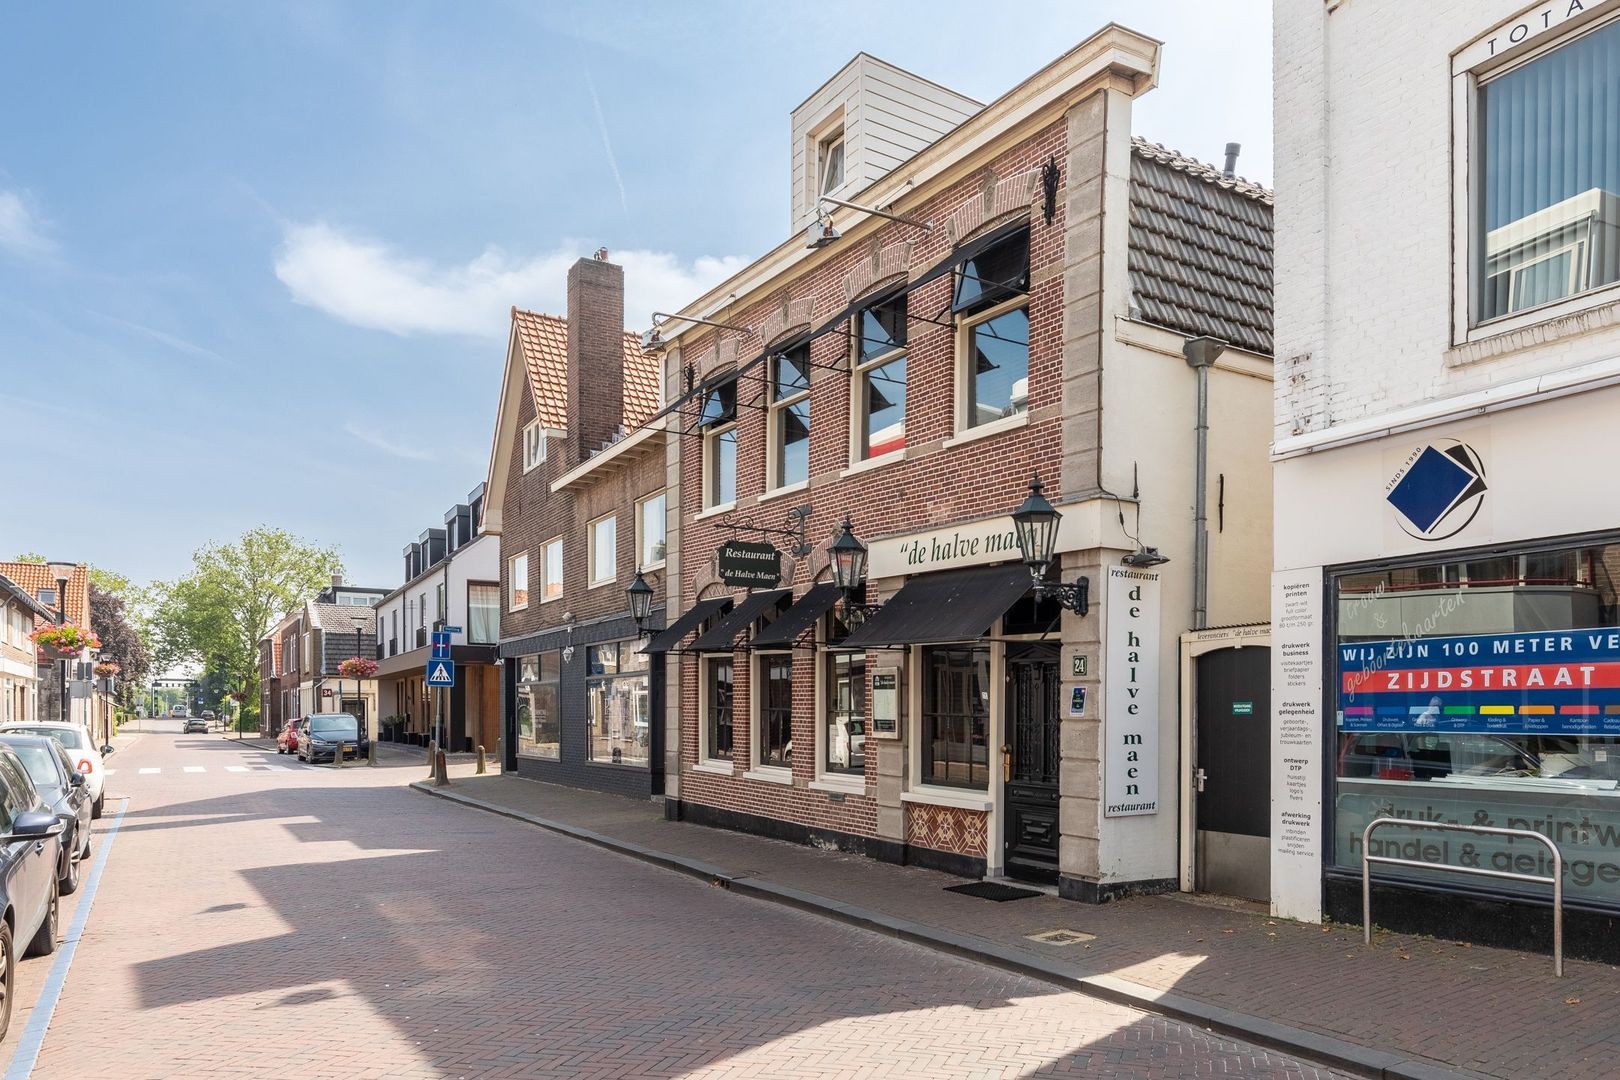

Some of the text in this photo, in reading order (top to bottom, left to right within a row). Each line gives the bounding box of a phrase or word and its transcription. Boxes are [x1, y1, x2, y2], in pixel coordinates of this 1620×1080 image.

[1386, 447, 1422, 491] SINDS 1990
[725, 547, 776, 560] Restaurant
[931, 533, 979, 562] halve
[734, 570, 756, 579] Halve
[1111, 568, 1159, 581] restaurant
[1346, 580, 1385, 619] trouw
[1373, 612, 1388, 629] &
[1342, 635, 1619, 661] WIJ ZIJN 100 METER VE
[1075, 659, 1084, 672] 24
[1387, 667, 1595, 689] ZIJDSTRAAT
[1123, 586, 1142, 795] de halve maen
[1108, 801, 1156, 813] restaurant
[1281, 811, 1311, 820] afwerking
[1472, 809, 1495, 836] &
[1350, 831, 1448, 864] handel
[1460, 843, 1480, 867] &
